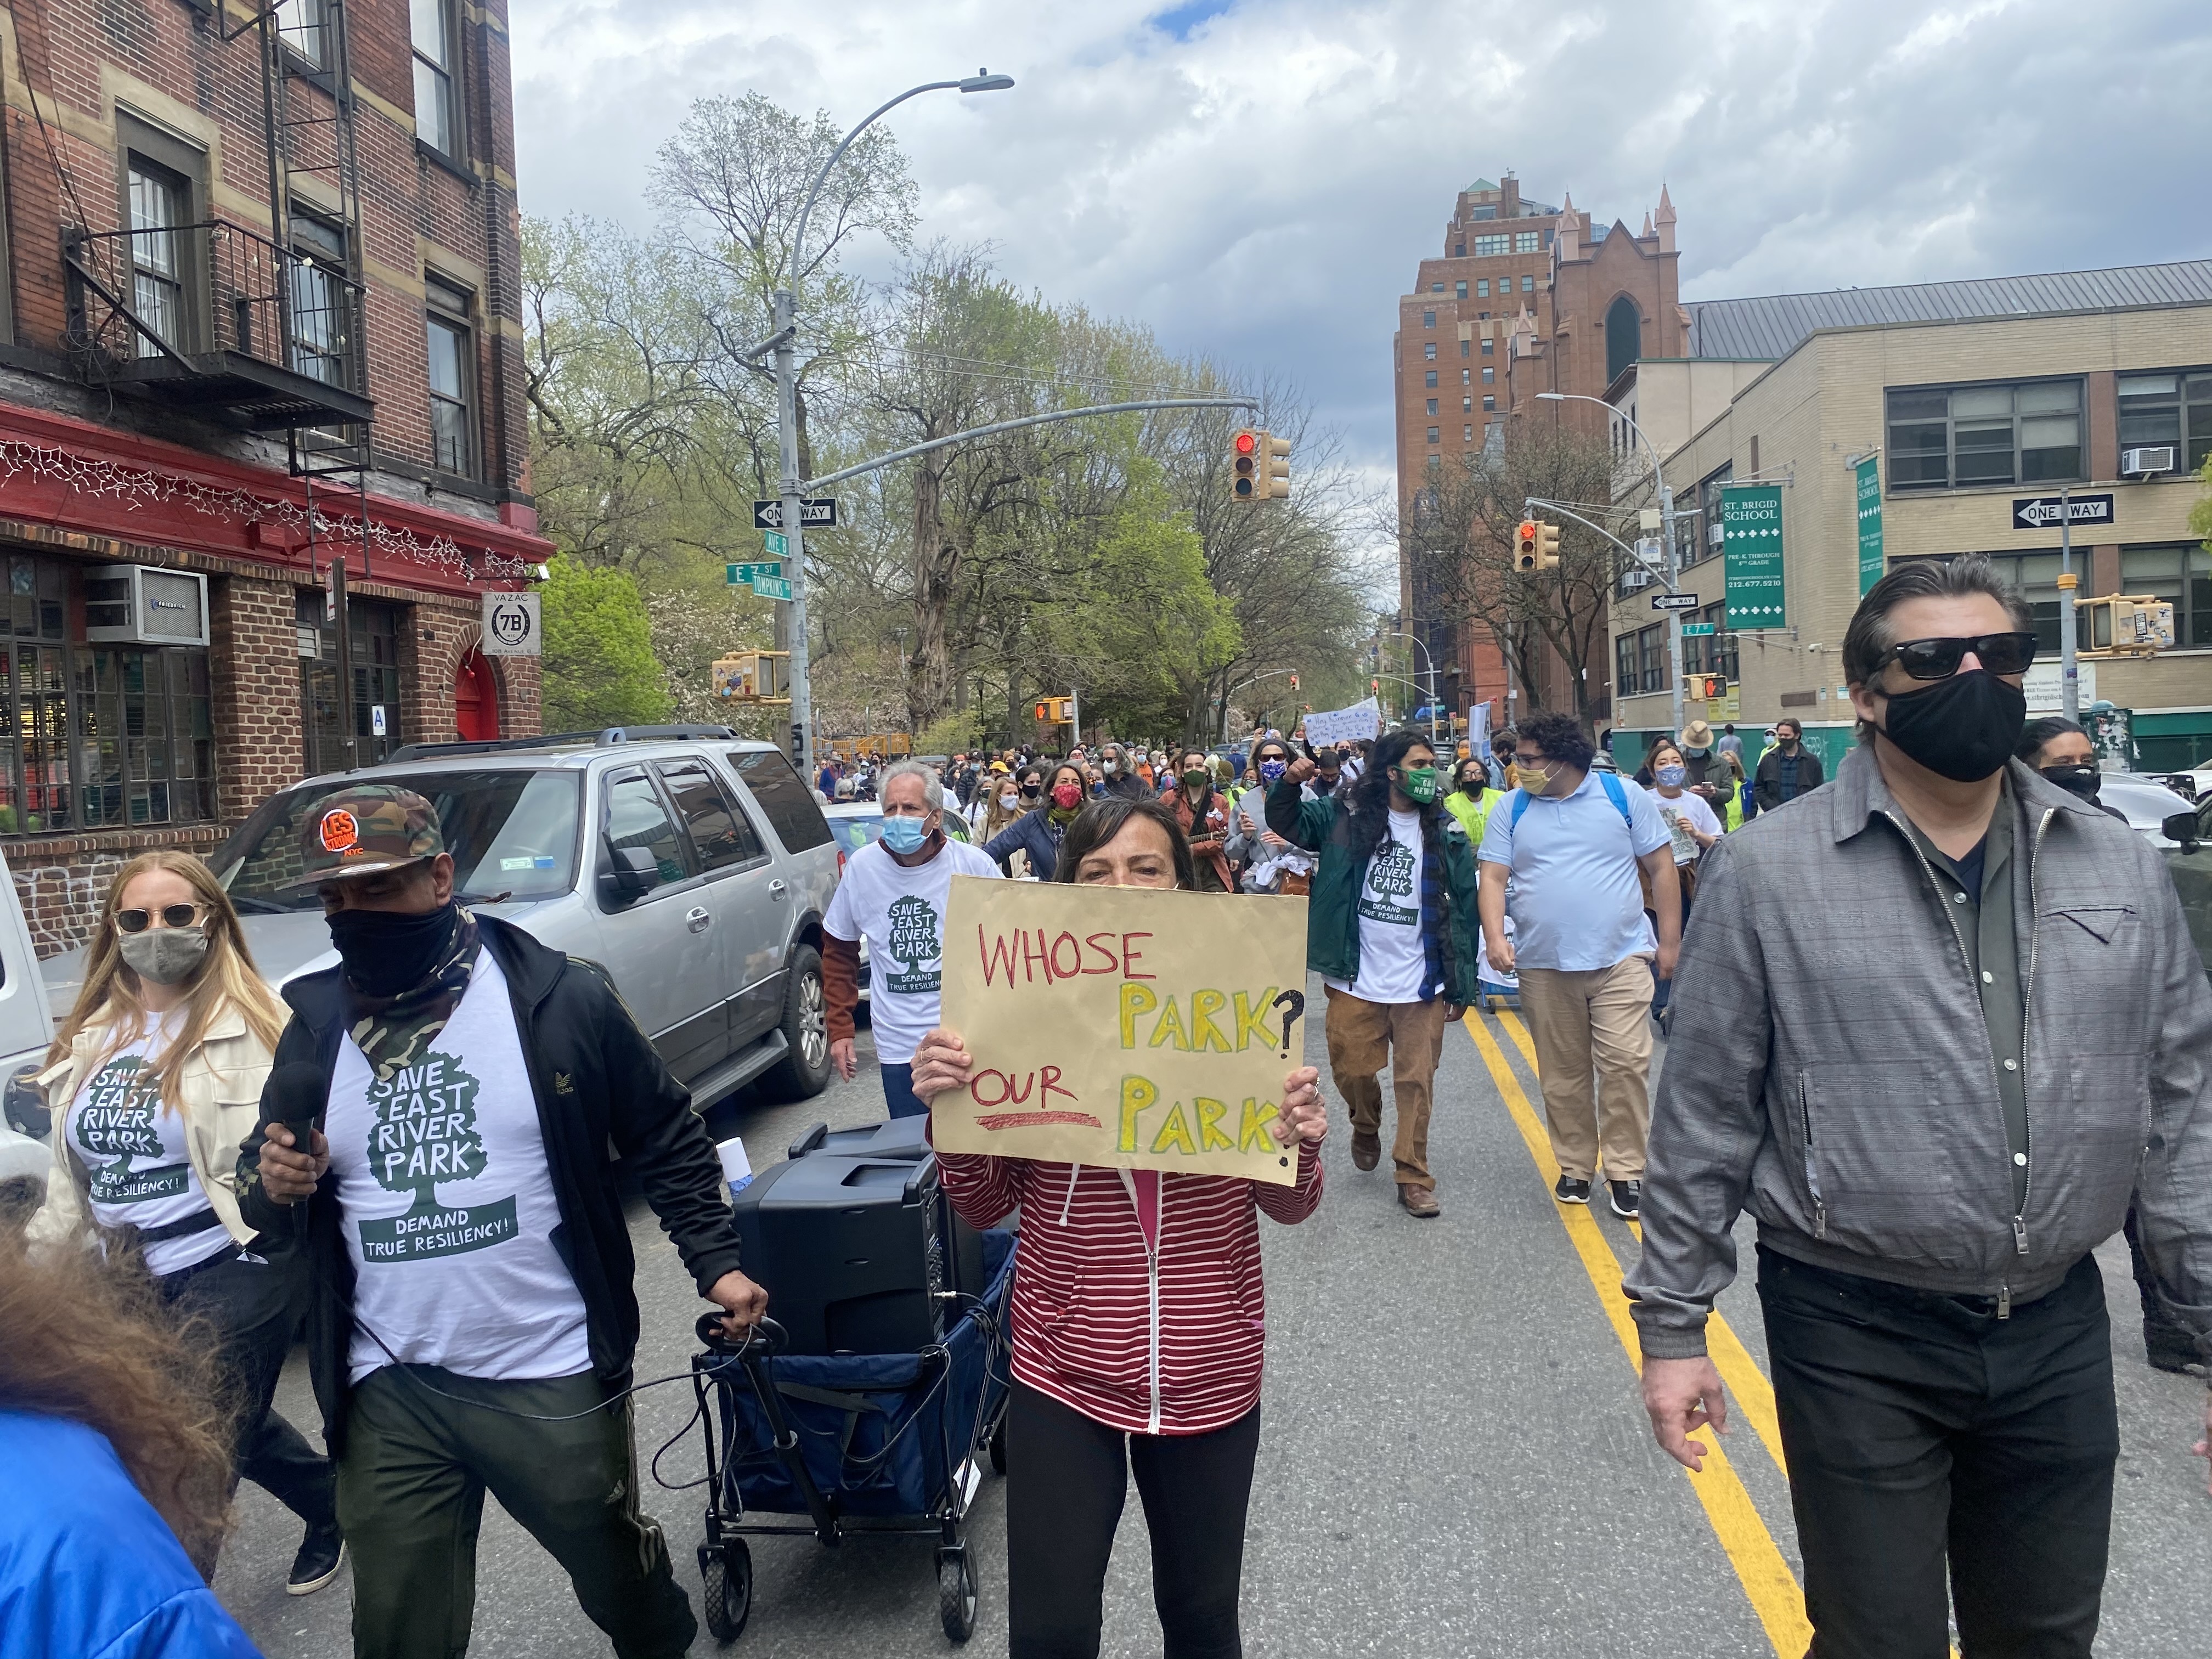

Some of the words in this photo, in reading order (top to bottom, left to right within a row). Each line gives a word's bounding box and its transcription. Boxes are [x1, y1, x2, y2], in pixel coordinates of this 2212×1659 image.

[766, 509, 782, 520] ON
[801, 507, 826, 518] WAY
[1724, 502, 1739, 510] ST.
[1742, 500, 1777, 510] BRIGID
[2028, 507, 2056, 519] ONE
[2070, 504, 2100, 517] WAY
[1724, 510, 1778, 521] SCHOOL
[768, 533, 780, 552] AVE
[782, 538, 787, 554] B
[736, 566, 744, 582] E
[765, 565, 773, 573] ST
[753, 576, 783, 596] TOMPKINS
[1728, 580, 1781, 588] 212.677.5210
[500, 614, 521, 631] 7B
[1686, 626, 1691, 635] E
[1695, 625, 1700, 634] 7
[374, 709, 383, 727] A
[1314, 715, 1327, 725] Hey
[321, 812, 354, 840] LES
[325, 831, 358, 851] STRONG
[344, 848, 364, 857] NYC
[1378, 845, 1405, 857] SVE
[1380, 856, 1412, 869] EAST
[1373, 865, 1408, 879] RIVER
[1373, 876, 1408, 894] PARK
[890, 902, 922, 917] SAVE
[1361, 907, 1375, 917] TRUE
[1378, 911, 1414, 923] RESILIENCY!
[1373, 903, 1401, 913] DEMAND
[897, 913, 933, 929] EAST
[893, 927, 932, 943] RIVER
[896, 940, 934, 958] PARK
[978, 923, 1157, 989] WHOSE
[889, 983, 908, 991] TRUE
[910, 979, 941, 990] RESILIEN
[901, 973, 933, 983] DEMAND
[1119, 981, 1305, 1060] PARK?
[95, 1068, 149, 1087] SAVE
[374, 1060, 444, 1097] SAVE
[971, 1065, 1079, 1109] OUR
[95, 1087, 158, 1108] EAST
[388, 1081, 470, 1122] EAST
[83, 1108, 148, 1130] RIVER
[88, 1129, 153, 1153] PARK
[378, 1113, 466, 1152] RIVER
[385, 1141, 472, 1182] PARK
[91, 1183, 103, 1197] RUE
[107, 1177, 179, 1199] RESILIENCY!
[396, 1210, 469, 1235] DEMAND
[365, 1239, 407, 1256] TRUE
[415, 1217, 509, 1252] RESILIENCY!
